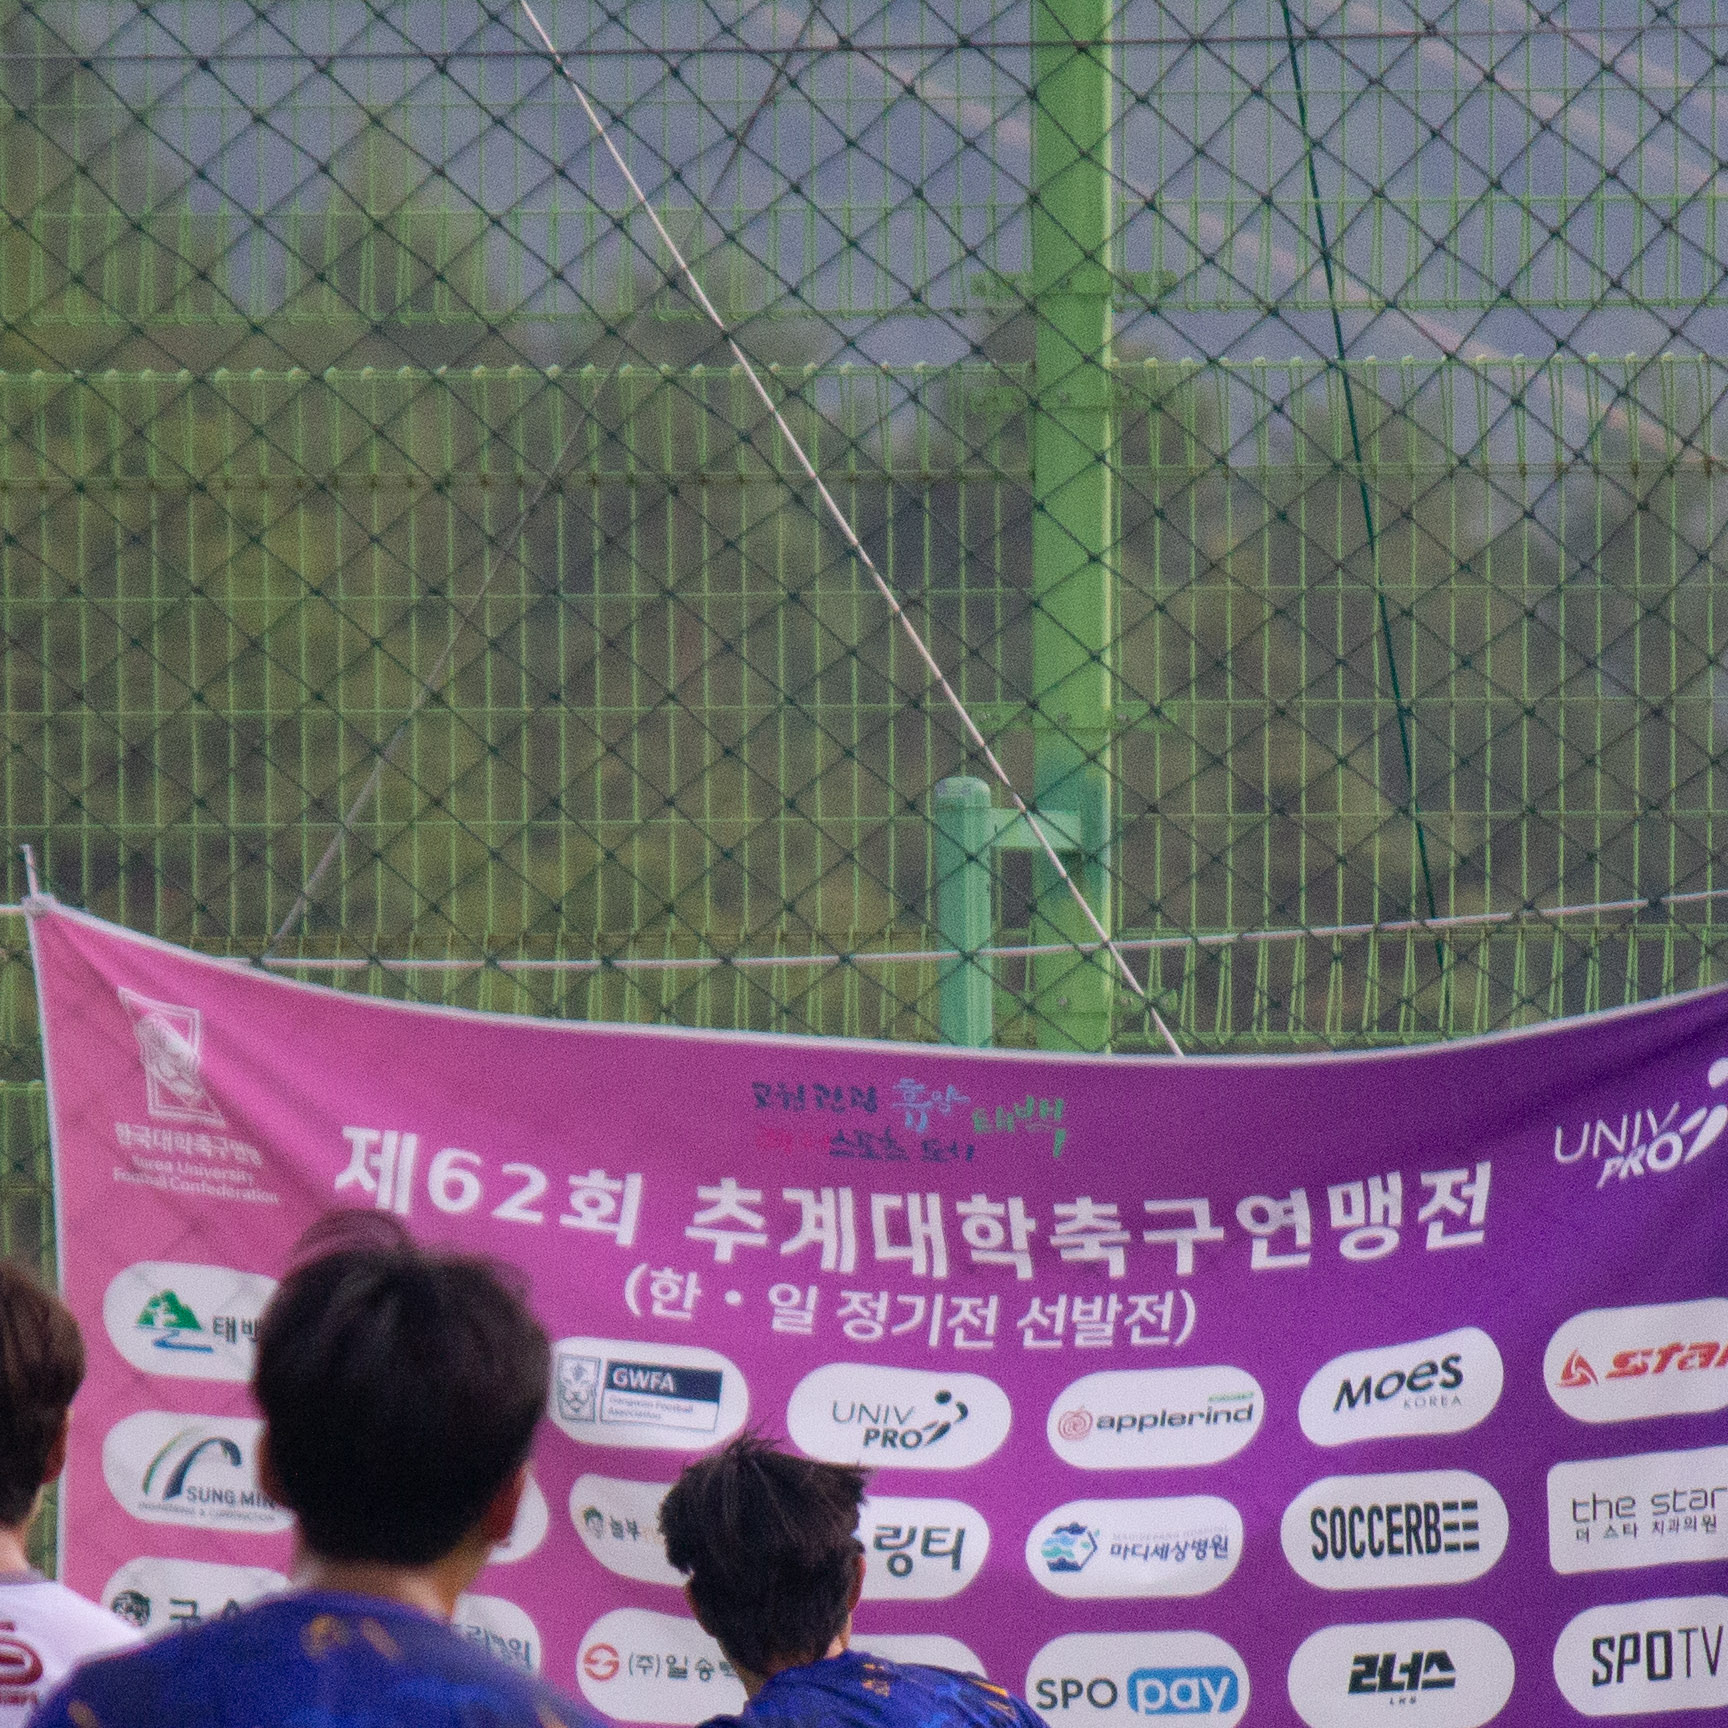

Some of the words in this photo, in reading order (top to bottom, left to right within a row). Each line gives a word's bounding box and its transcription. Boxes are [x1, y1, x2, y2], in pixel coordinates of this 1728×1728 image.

[1553, 1100, 1680, 1165] UNIV
[1597, 1130, 1684, 1188] PRO
[333, 1125, 644, 1246] 제62회
[684, 1160, 1492, 1279] 추계대학축구연맹전
[836, 1285, 1000, 1352] 정기전
[1016, 1286, 1196, 1352] 선발전)
[612, 1366, 677, 1394] GWFA
[831, 1400, 915, 1426] UNIV
[1096, 1403, 1255, 1434] applerind
[1403, 1394, 1463, 1410] KOREA
[862, 1428, 924, 1451] PRO
[186, 1484, 236, 1508] SUNG
[1572, 1492, 1636, 1524] the
[1651, 1486, 1728, 1517] star
[1110, 1533, 1229, 1562] 마디세상병원
[1310, 1499, 1480, 1561] SOCCERBEE
[1603, 1522, 1638, 1539] 스타
[872, 1523, 967, 1578] 링티
[1591, 1625, 1724, 1688] SPOTV
[1036, 1678, 1119, 1711] SPO
[1134, 1676, 1231, 1715] pay
